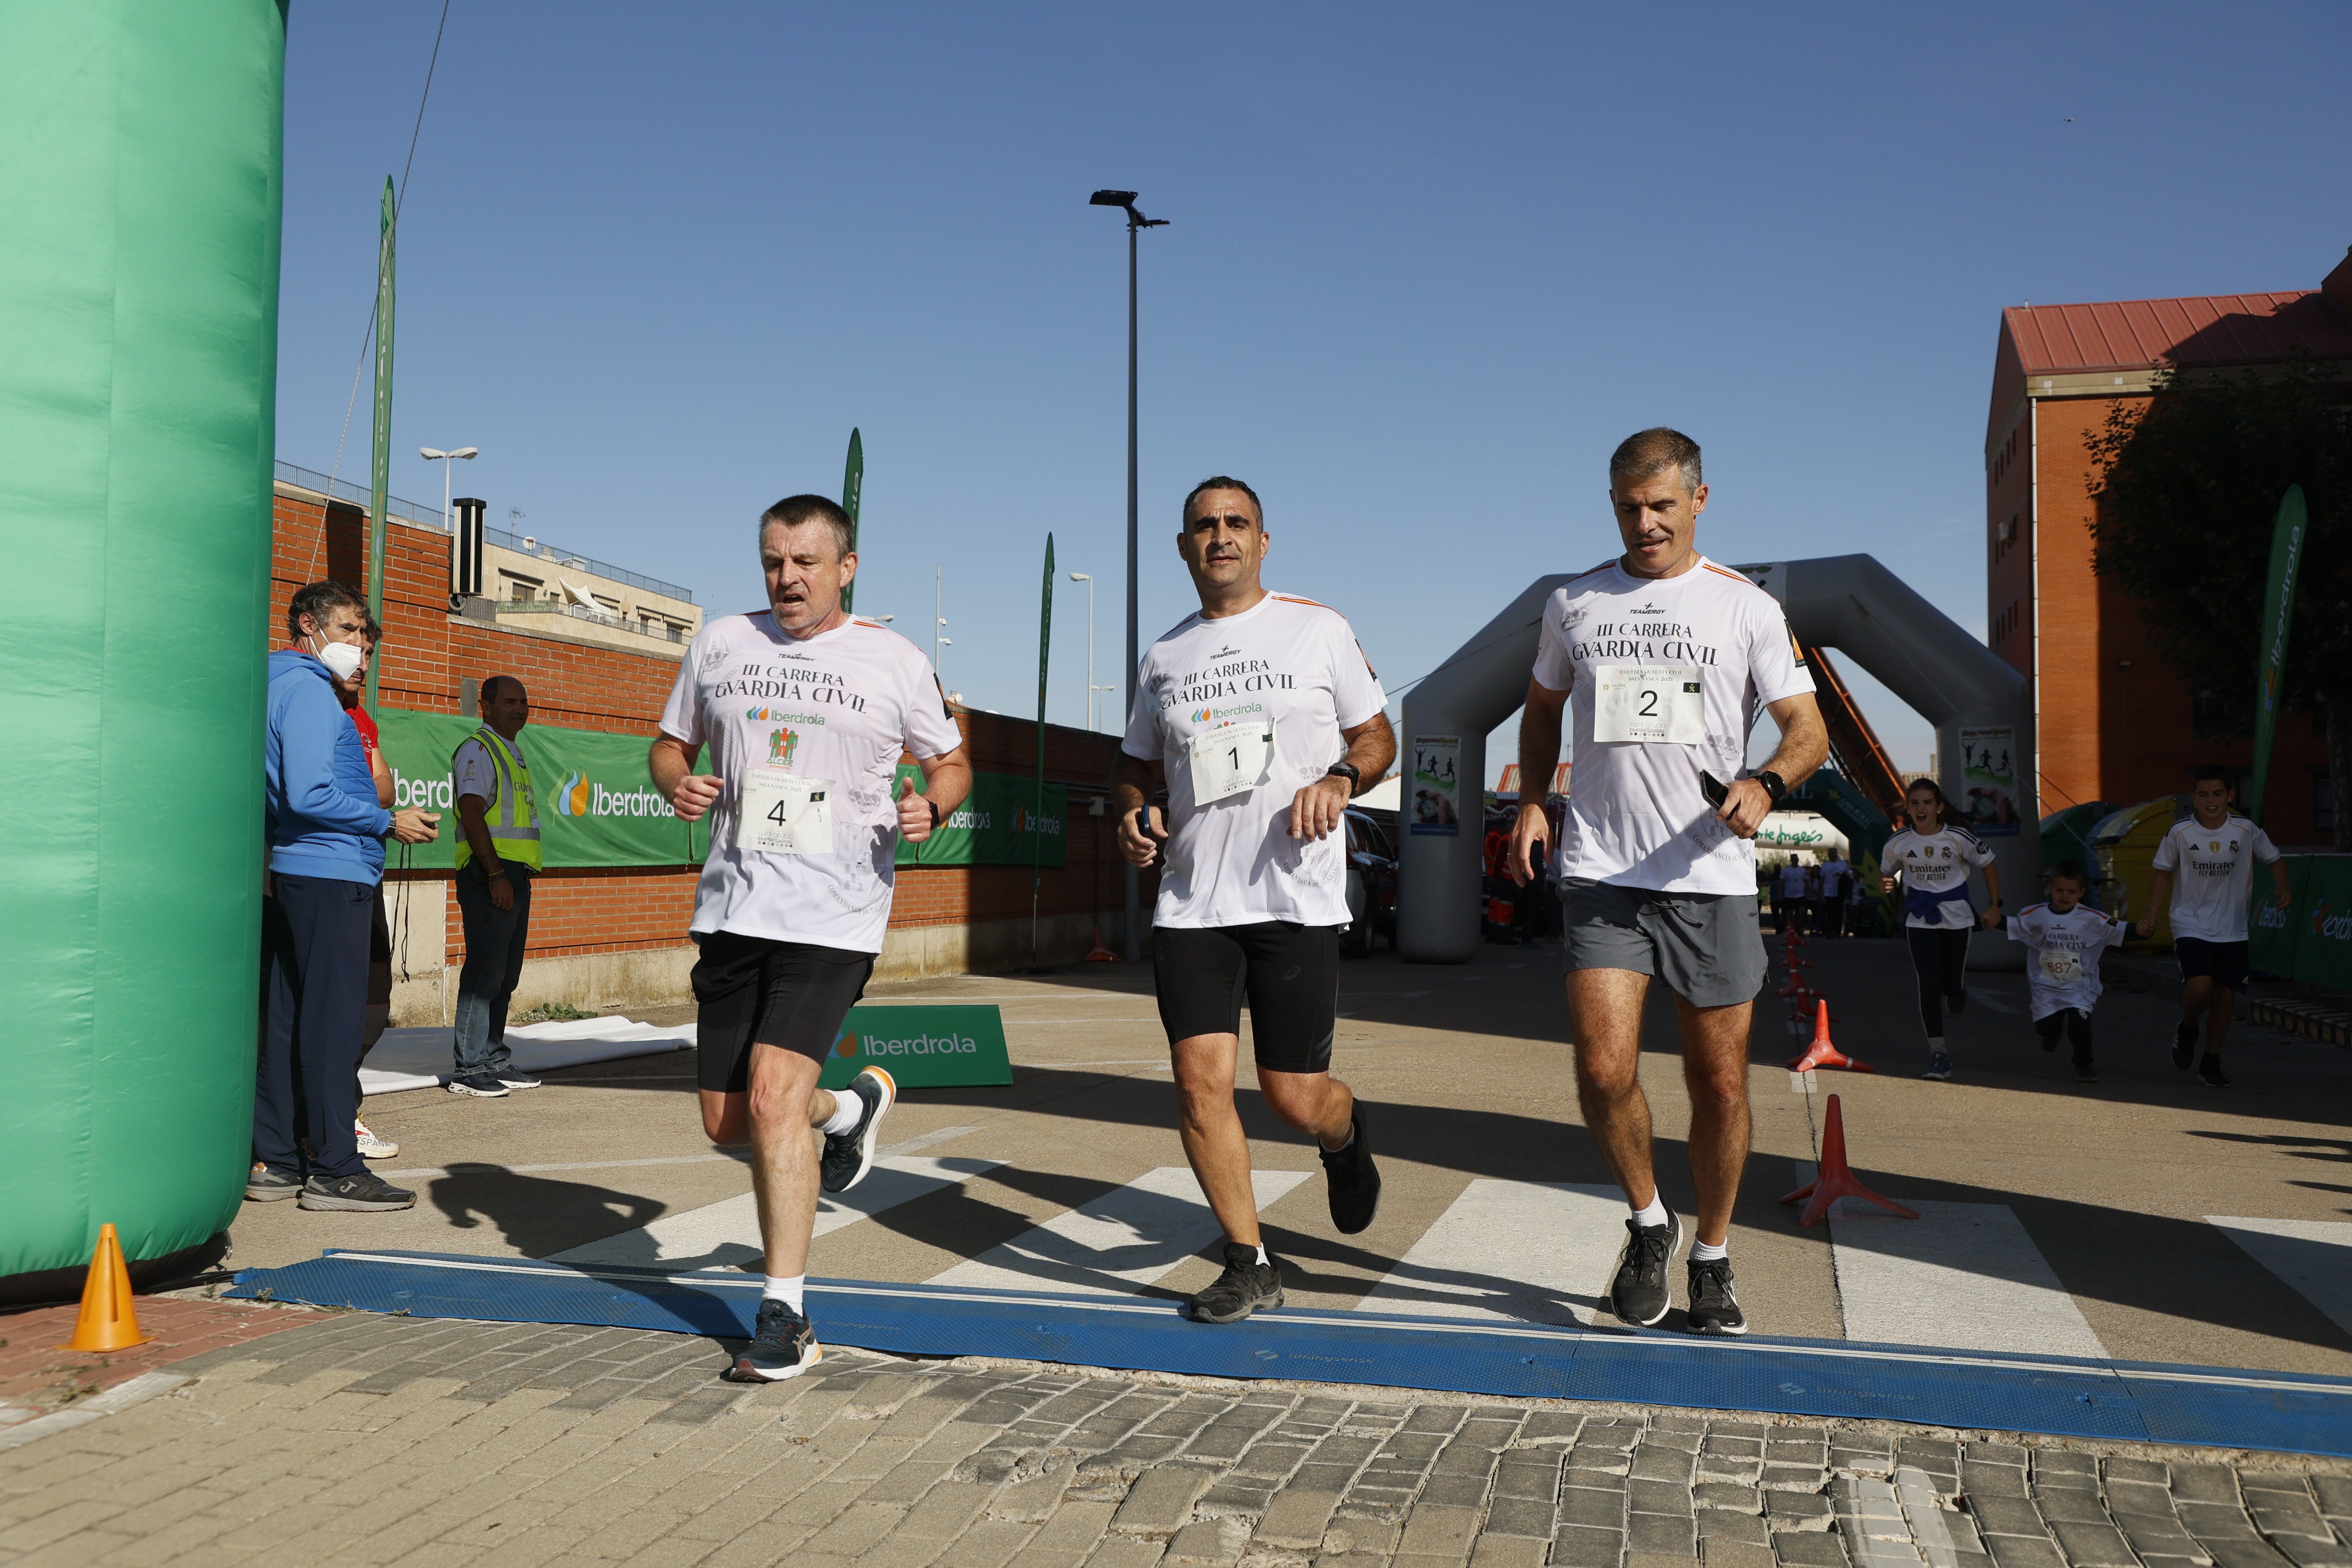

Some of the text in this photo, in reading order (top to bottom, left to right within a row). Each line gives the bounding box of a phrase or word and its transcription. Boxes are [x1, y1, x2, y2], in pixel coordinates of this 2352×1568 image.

[1596, 623, 1693, 638] III CARRERA
[778, 653, 816, 662] TEAMERGY
[1209, 648, 1242, 661] TEAMERGY
[1572, 640, 1719, 666] GVARDIA CIVIL
[742, 665, 845, 686] III CARRERA
[1184, 659, 1271, 686] III CARRERA
[715, 680, 867, 714] GVARDIA CIVIL
[1161, 674, 1298, 710] GVARDIA CIVIL
[1213, 702, 1262, 719] Iberdrola
[1638, 690, 1658, 717] 2
[772, 710, 825, 726] Iberdrola
[1206, 731, 1226, 740] CARRERA
[1214, 734, 1240, 744] SALAMANCA
[766, 758, 793, 767] ALCER
[1228, 747, 1238, 770] 1
[759, 782, 788, 790] SALAMANCA
[1223, 778, 1252, 789] EMPRESARIAL
[593, 783, 675, 817] Iberdrola
[767, 800, 786, 827] 4
[758, 836, 793, 845] EMPRESARIAL
[1693, 835, 1731, 861] COMANDANCIA
[1909, 864, 1951, 873] Emirates
[2193, 861, 2235, 870] Emirates
[2047, 962, 2071, 974] 687
[863, 1033, 977, 1056] Iberdrola
